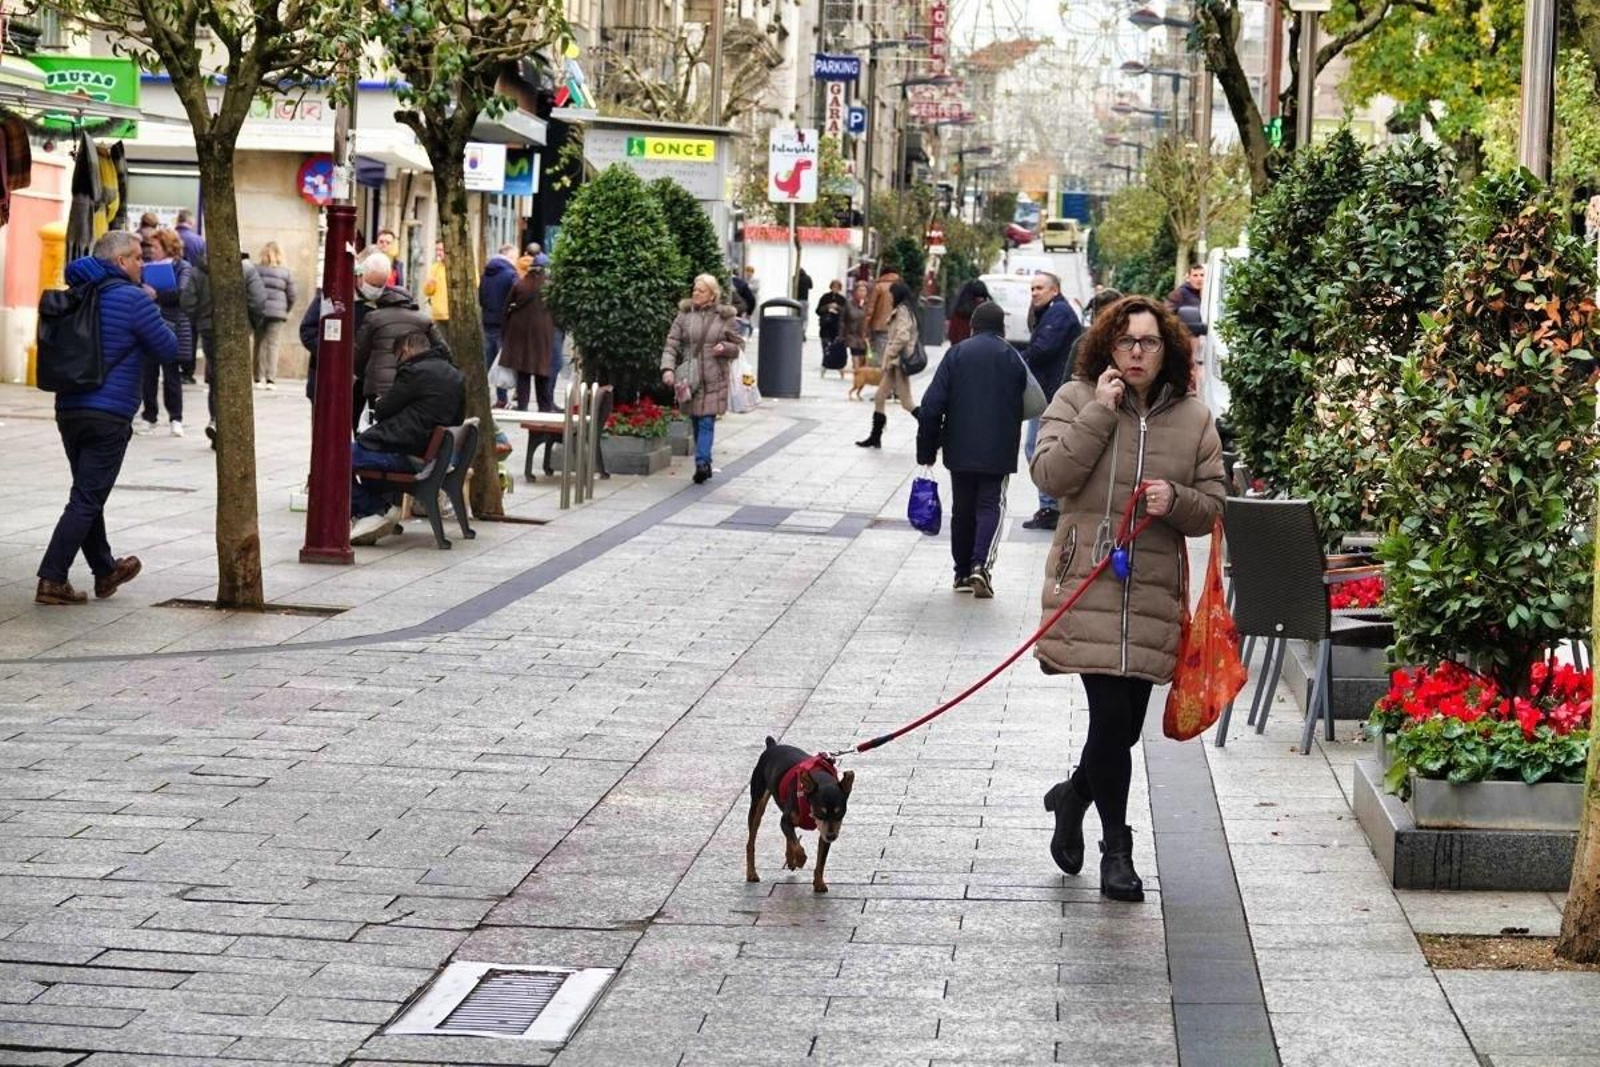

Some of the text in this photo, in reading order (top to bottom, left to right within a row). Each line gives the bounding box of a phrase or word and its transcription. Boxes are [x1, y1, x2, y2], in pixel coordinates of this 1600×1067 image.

[815, 60, 859, 74] PARKING
[46, 70, 115, 88] FRUTAS
[850, 112, 863, 128] P
[653, 142, 706, 157] ONCE
